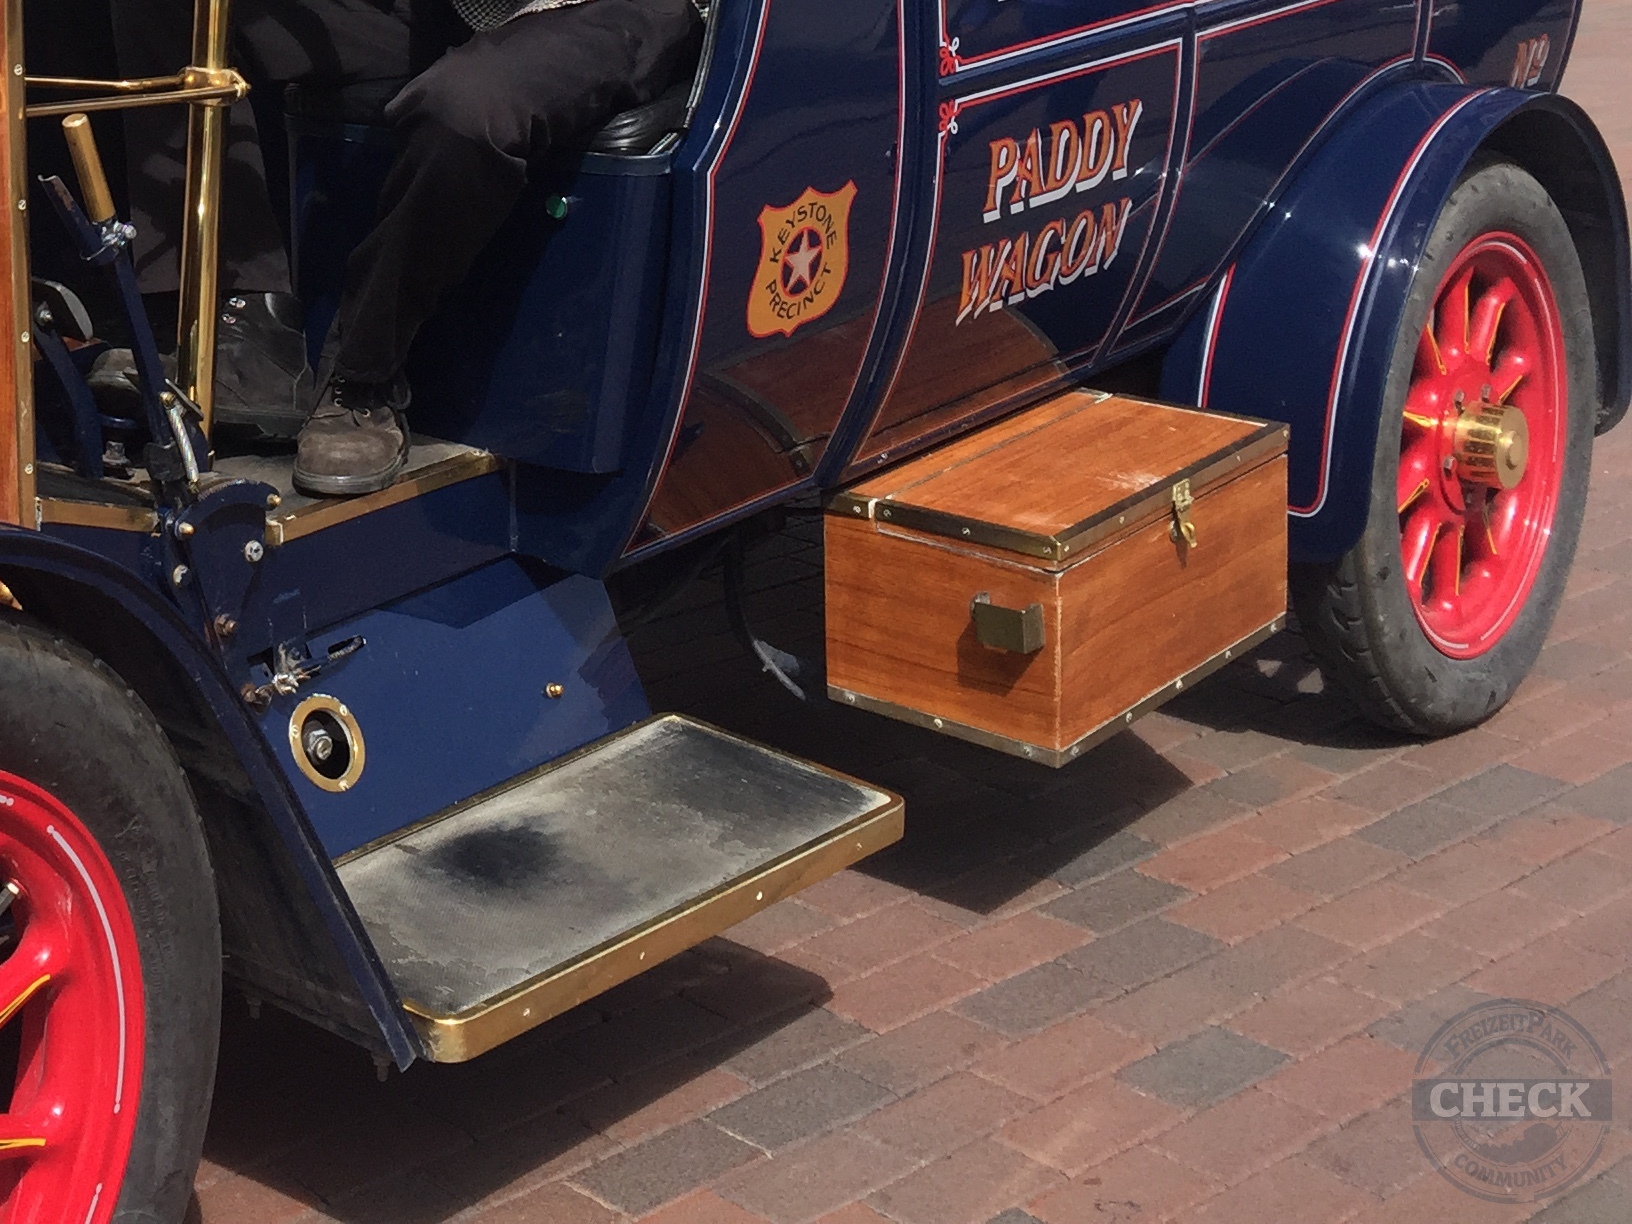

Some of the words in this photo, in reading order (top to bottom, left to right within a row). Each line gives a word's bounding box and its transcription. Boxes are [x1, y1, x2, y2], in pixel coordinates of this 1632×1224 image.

[982, 98, 1144, 224] PADDY
[769, 201, 837, 264] KEYSTONE
[954, 196, 1132, 327] WAGON
[765, 261, 832, 320] PRECINCT
